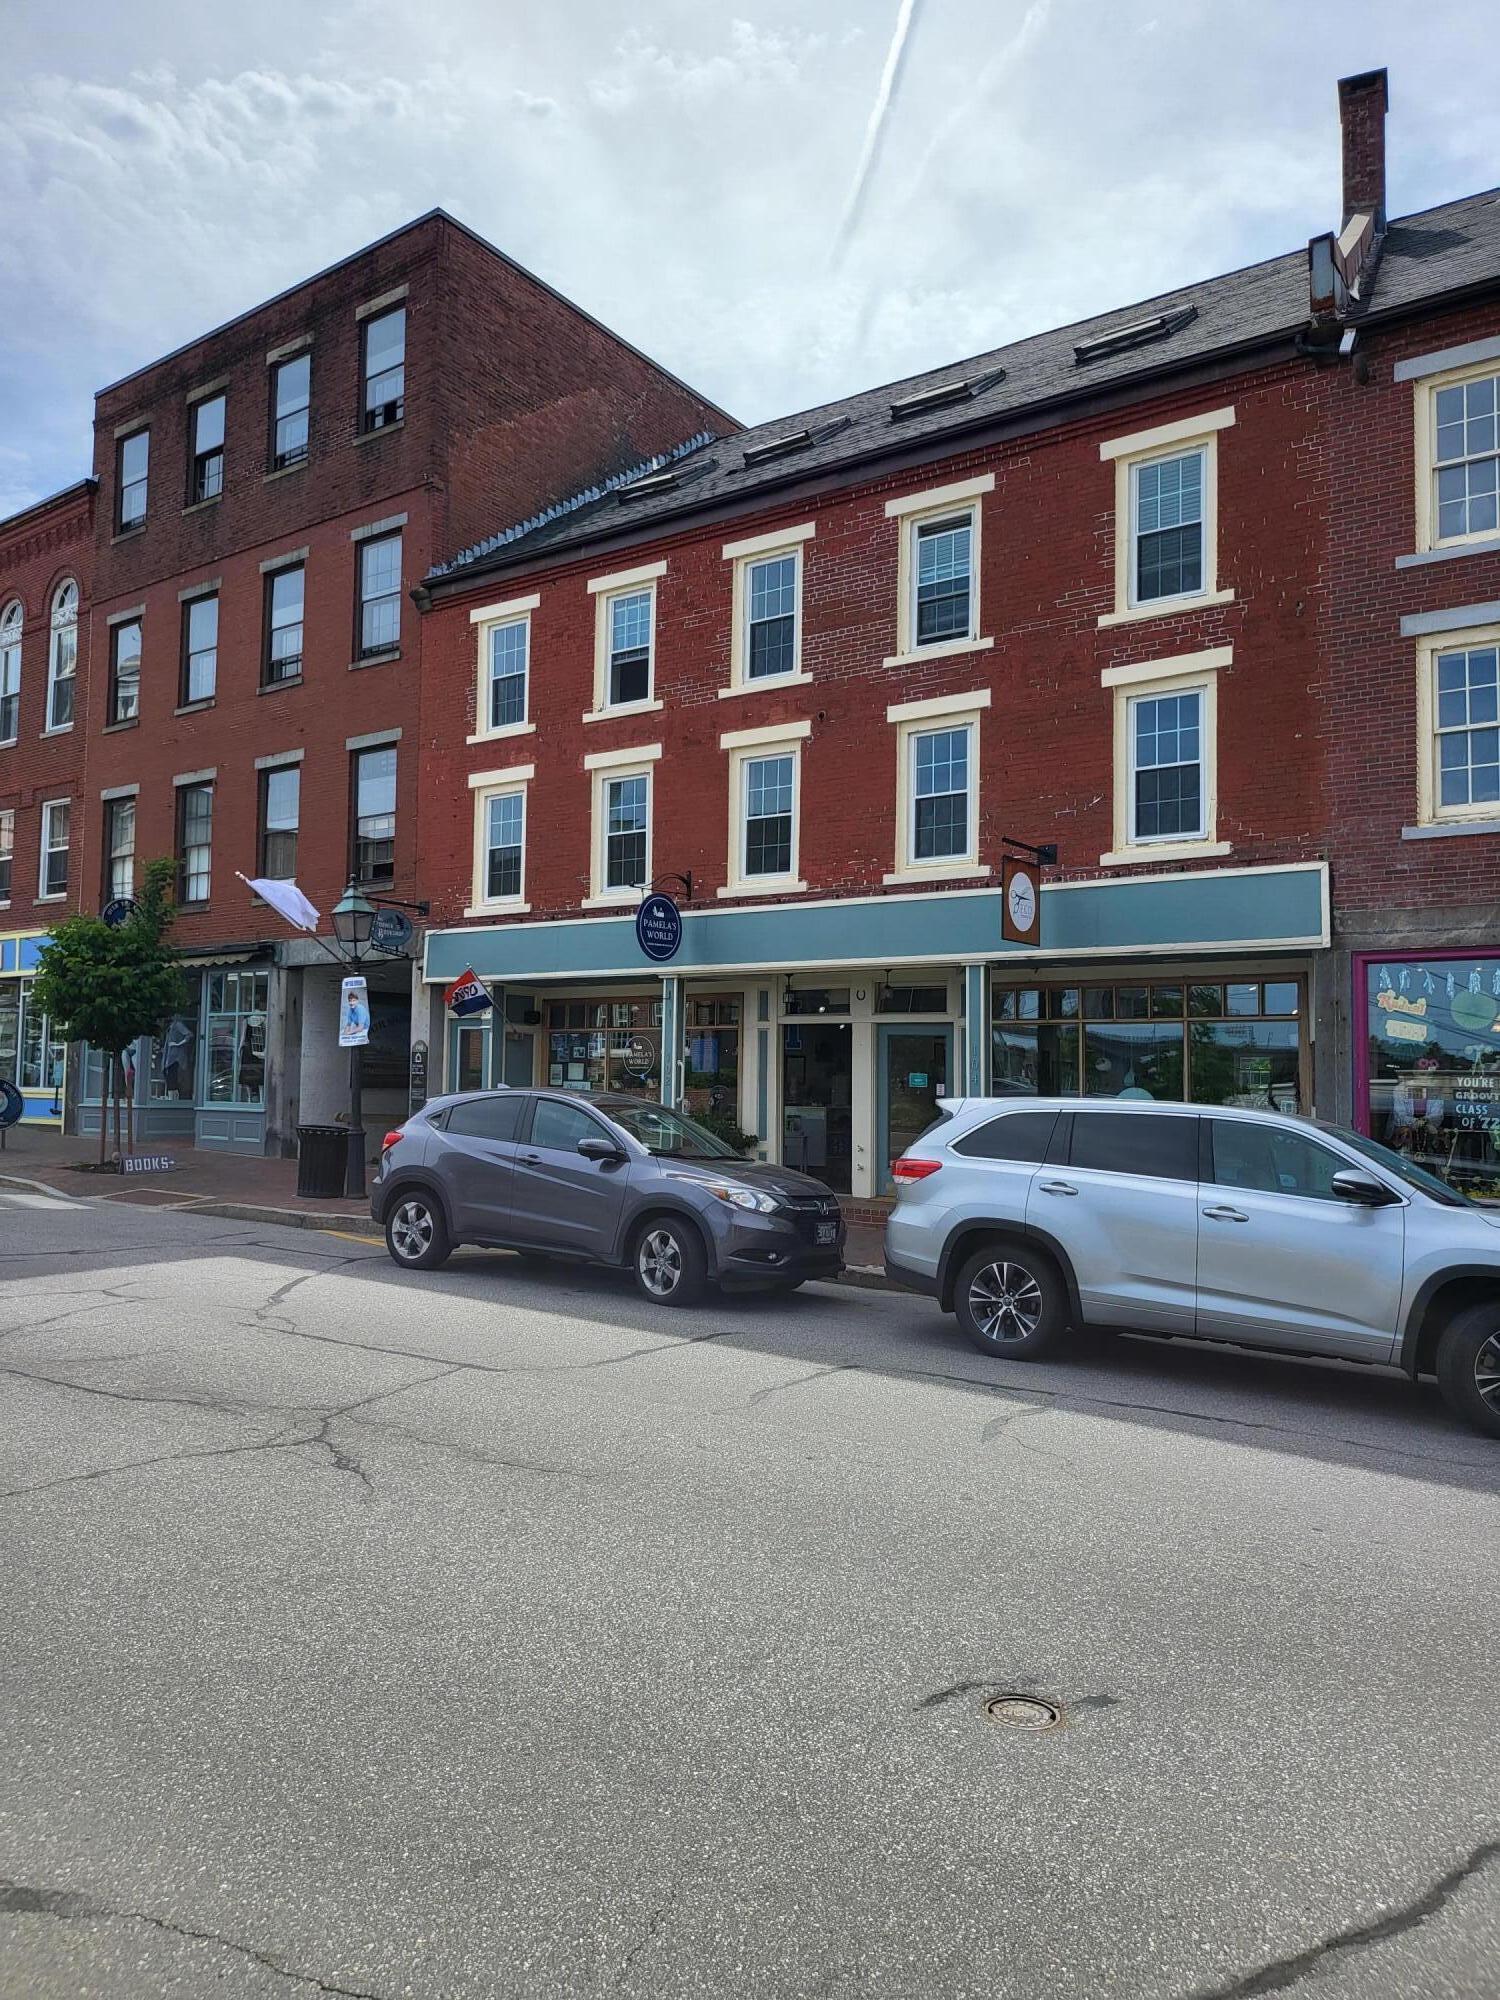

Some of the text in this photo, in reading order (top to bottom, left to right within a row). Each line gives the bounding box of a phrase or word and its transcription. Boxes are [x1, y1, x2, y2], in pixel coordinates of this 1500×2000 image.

[643, 918, 677, 931] PAMELA'S
[646, 930, 674, 941] WORLD
[1457, 1075, 1494, 1088] YOU'RE
[1456, 1104, 1488, 1115] CLASS
[1462, 1117, 1475, 1128] OF
[125, 1156, 169, 1172] BOOKS
